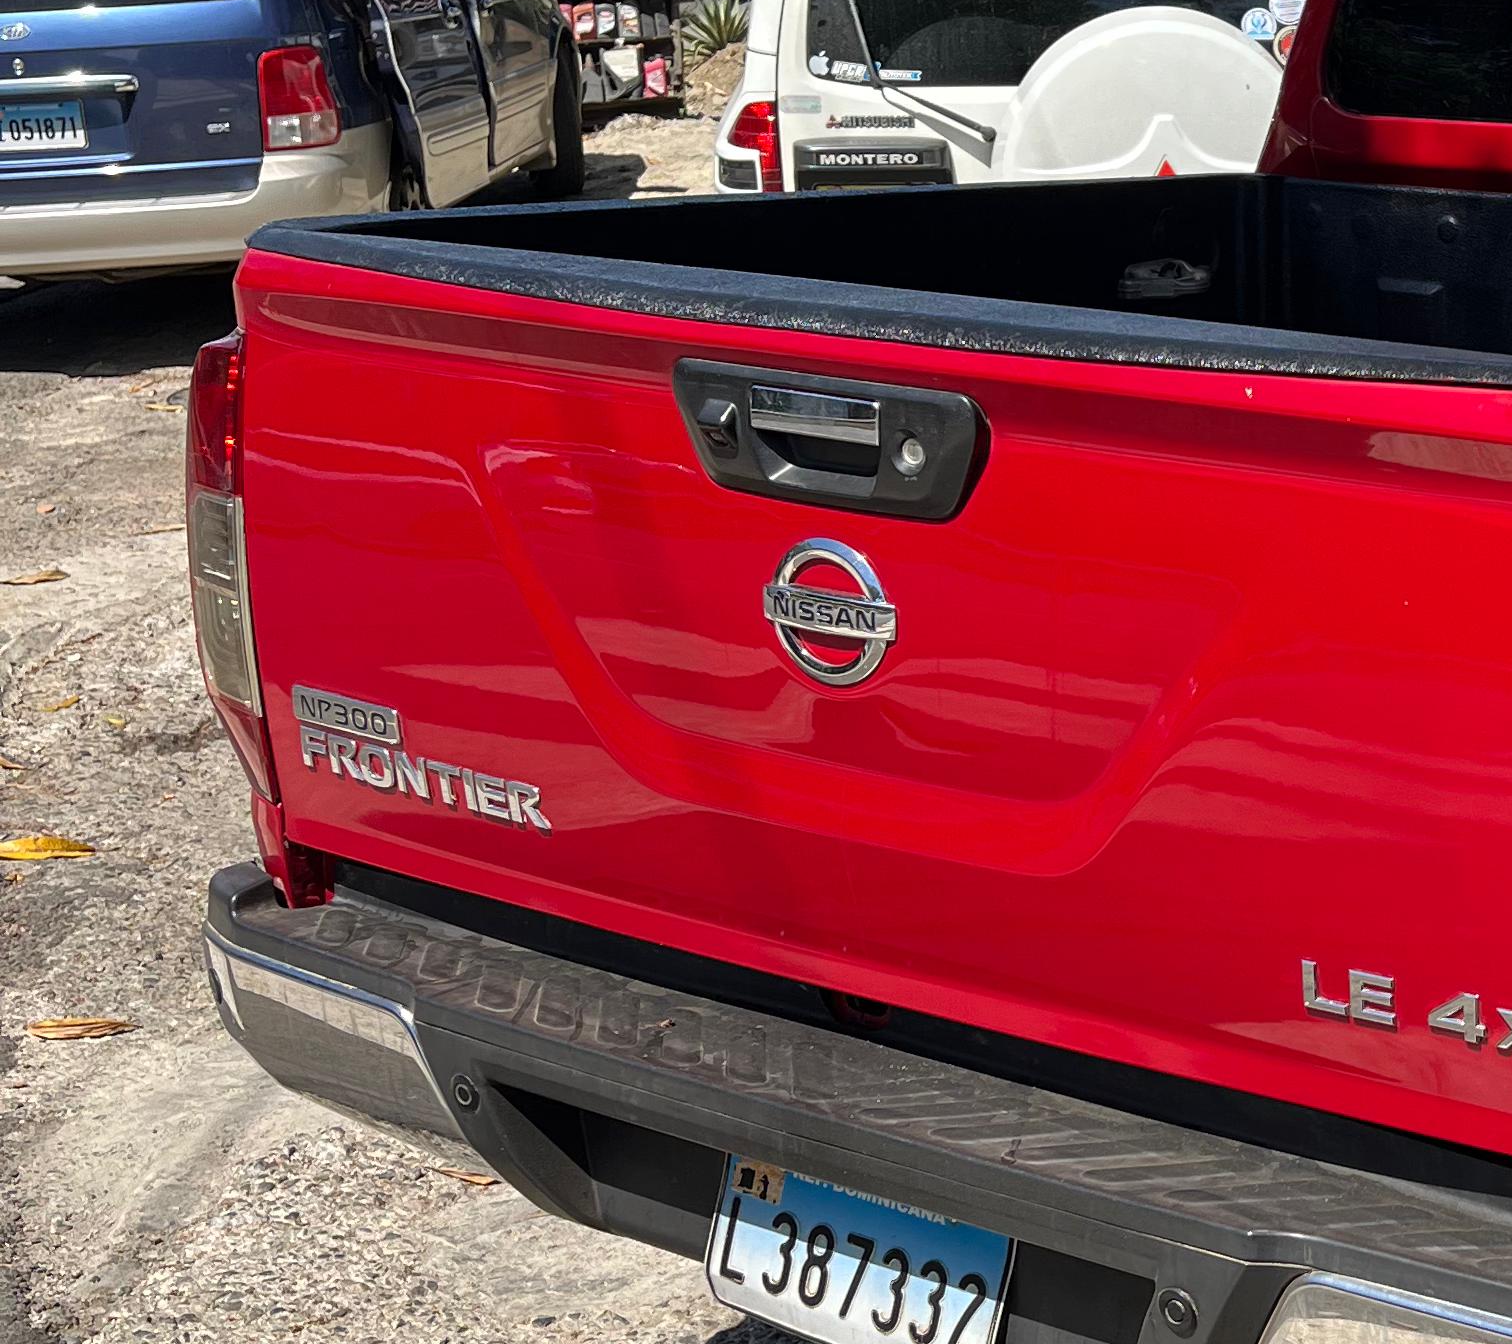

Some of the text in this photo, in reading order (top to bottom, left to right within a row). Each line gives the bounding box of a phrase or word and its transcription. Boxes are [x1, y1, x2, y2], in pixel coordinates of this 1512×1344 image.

[841, 116, 915, 129] MITSUBISHI
[819, 152, 919, 166] MONTERO
[772, 593, 877, 633] NISSAN
[300, 694, 388, 737] NP300
[300, 725, 553, 831] FRONTIER
[1301, 958, 1398, 1027] LE
